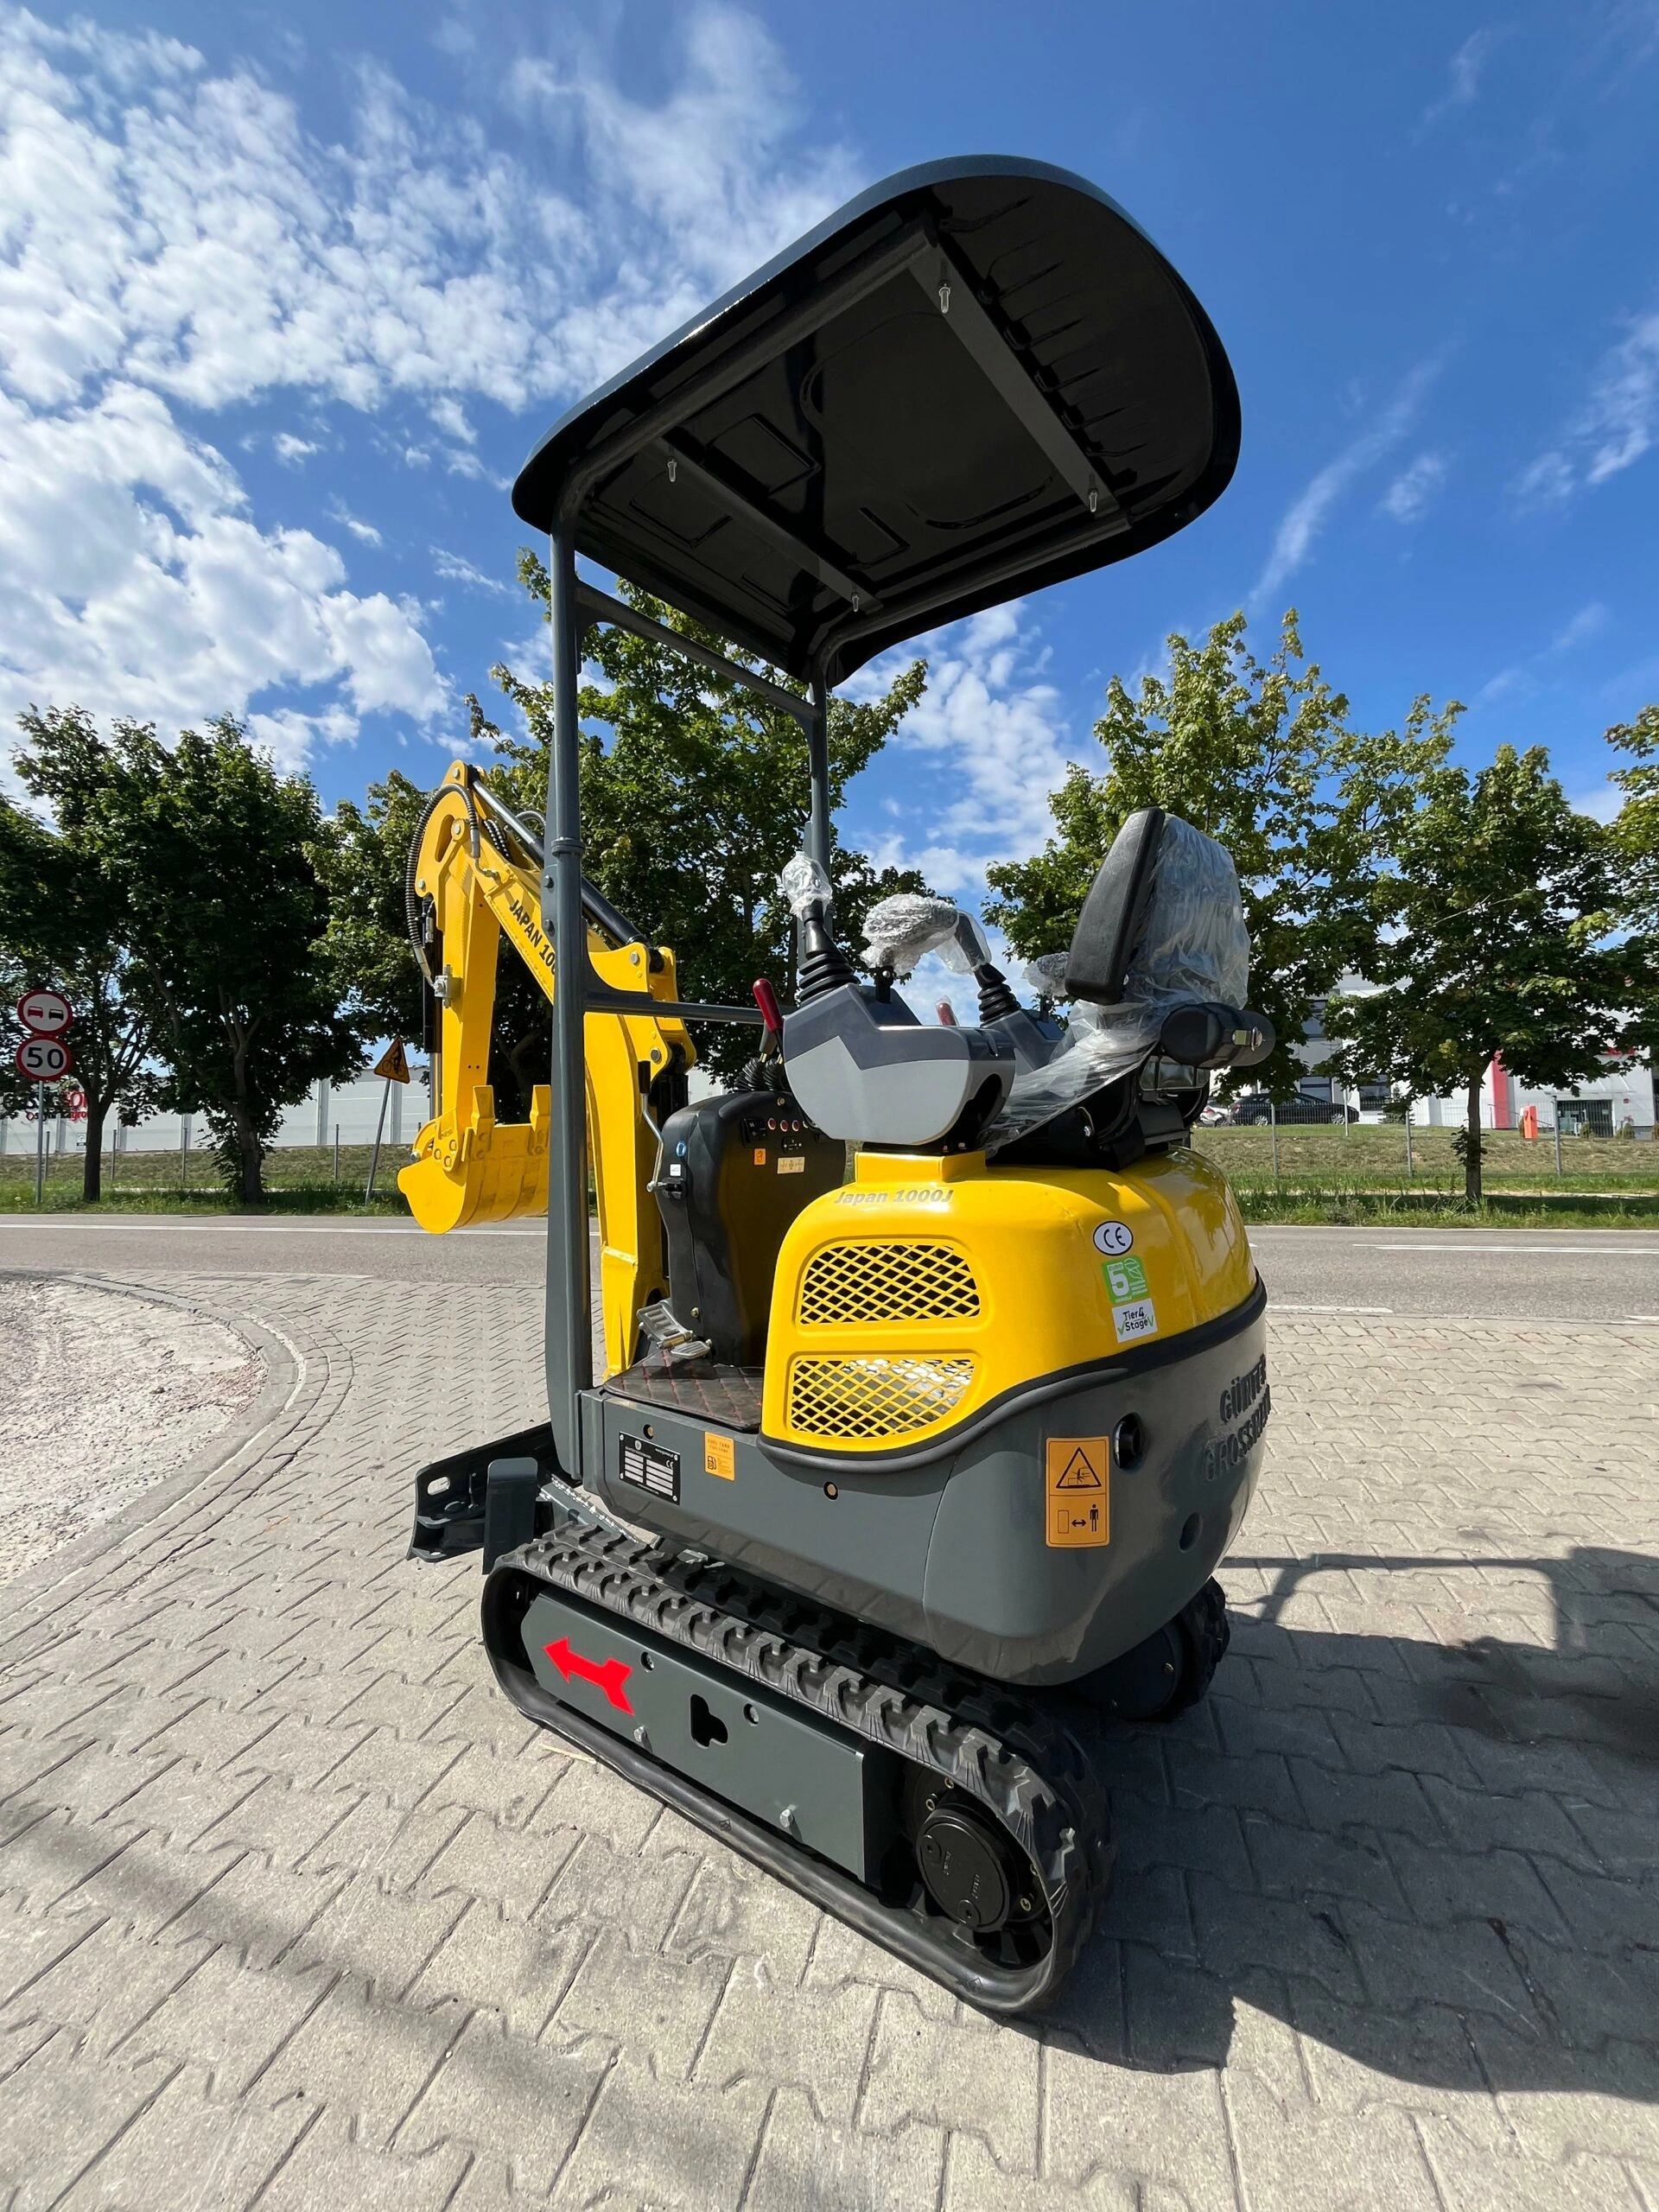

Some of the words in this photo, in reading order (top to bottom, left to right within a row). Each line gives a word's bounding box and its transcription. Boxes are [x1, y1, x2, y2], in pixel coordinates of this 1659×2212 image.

[508, 899, 543, 948] JAPAN
[27, 1046, 64, 1069] 50
[834, 1191, 888, 1206] Japan
[893, 1189, 954, 1203] 1000J
[1103, 1226, 1126, 1249] CE
[1108, 1264, 1129, 1296] 5
[1125, 1319, 1148, 1332] Stage
